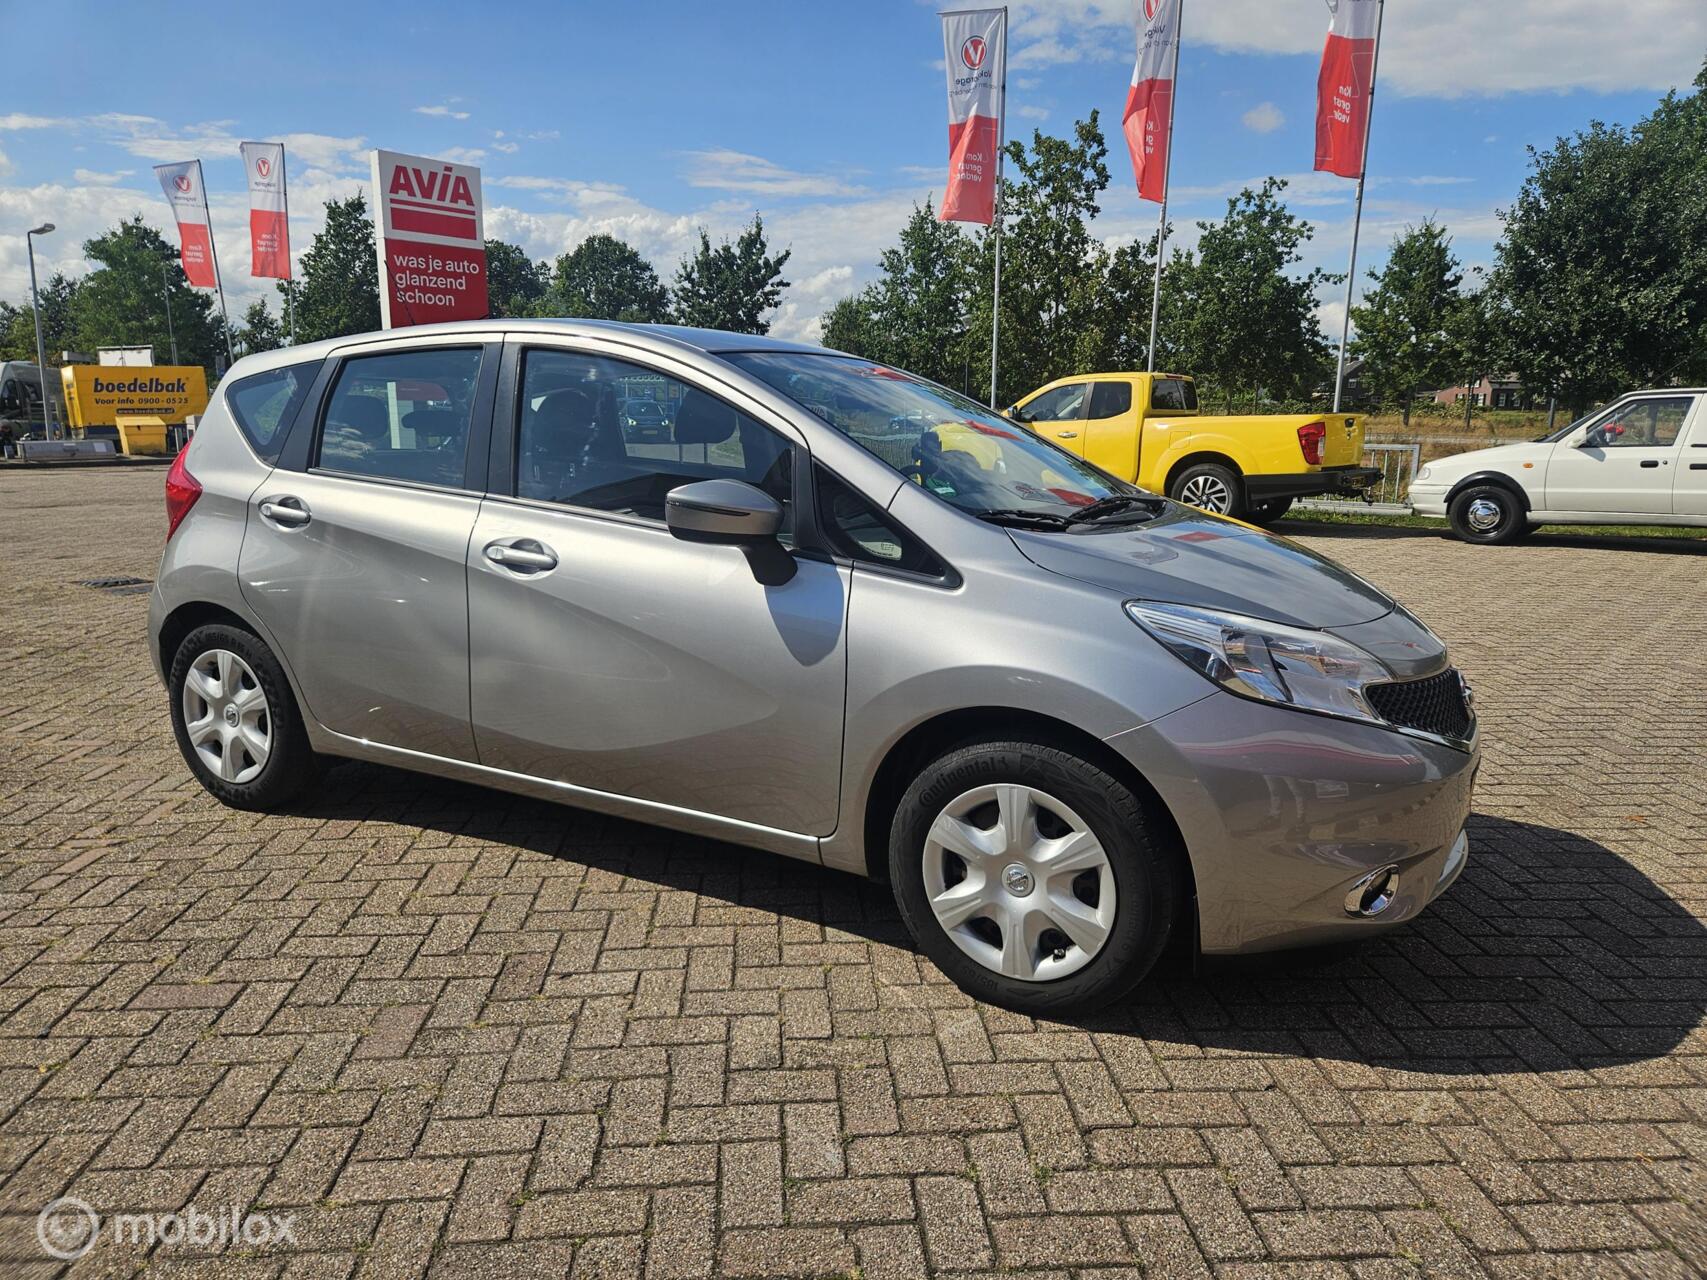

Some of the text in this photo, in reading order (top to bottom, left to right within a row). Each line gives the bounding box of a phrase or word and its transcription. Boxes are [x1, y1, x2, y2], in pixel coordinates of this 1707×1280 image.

[394, 255, 480, 274] was je auto
[395, 270, 466, 290] glanzend
[396, 288, 455, 306] schoon
[93, 377, 187, 393] boedelbak
[95, 397, 115, 405] Voor
[117, 396, 135, 405] info
[919, 756, 997, 808] Continental
